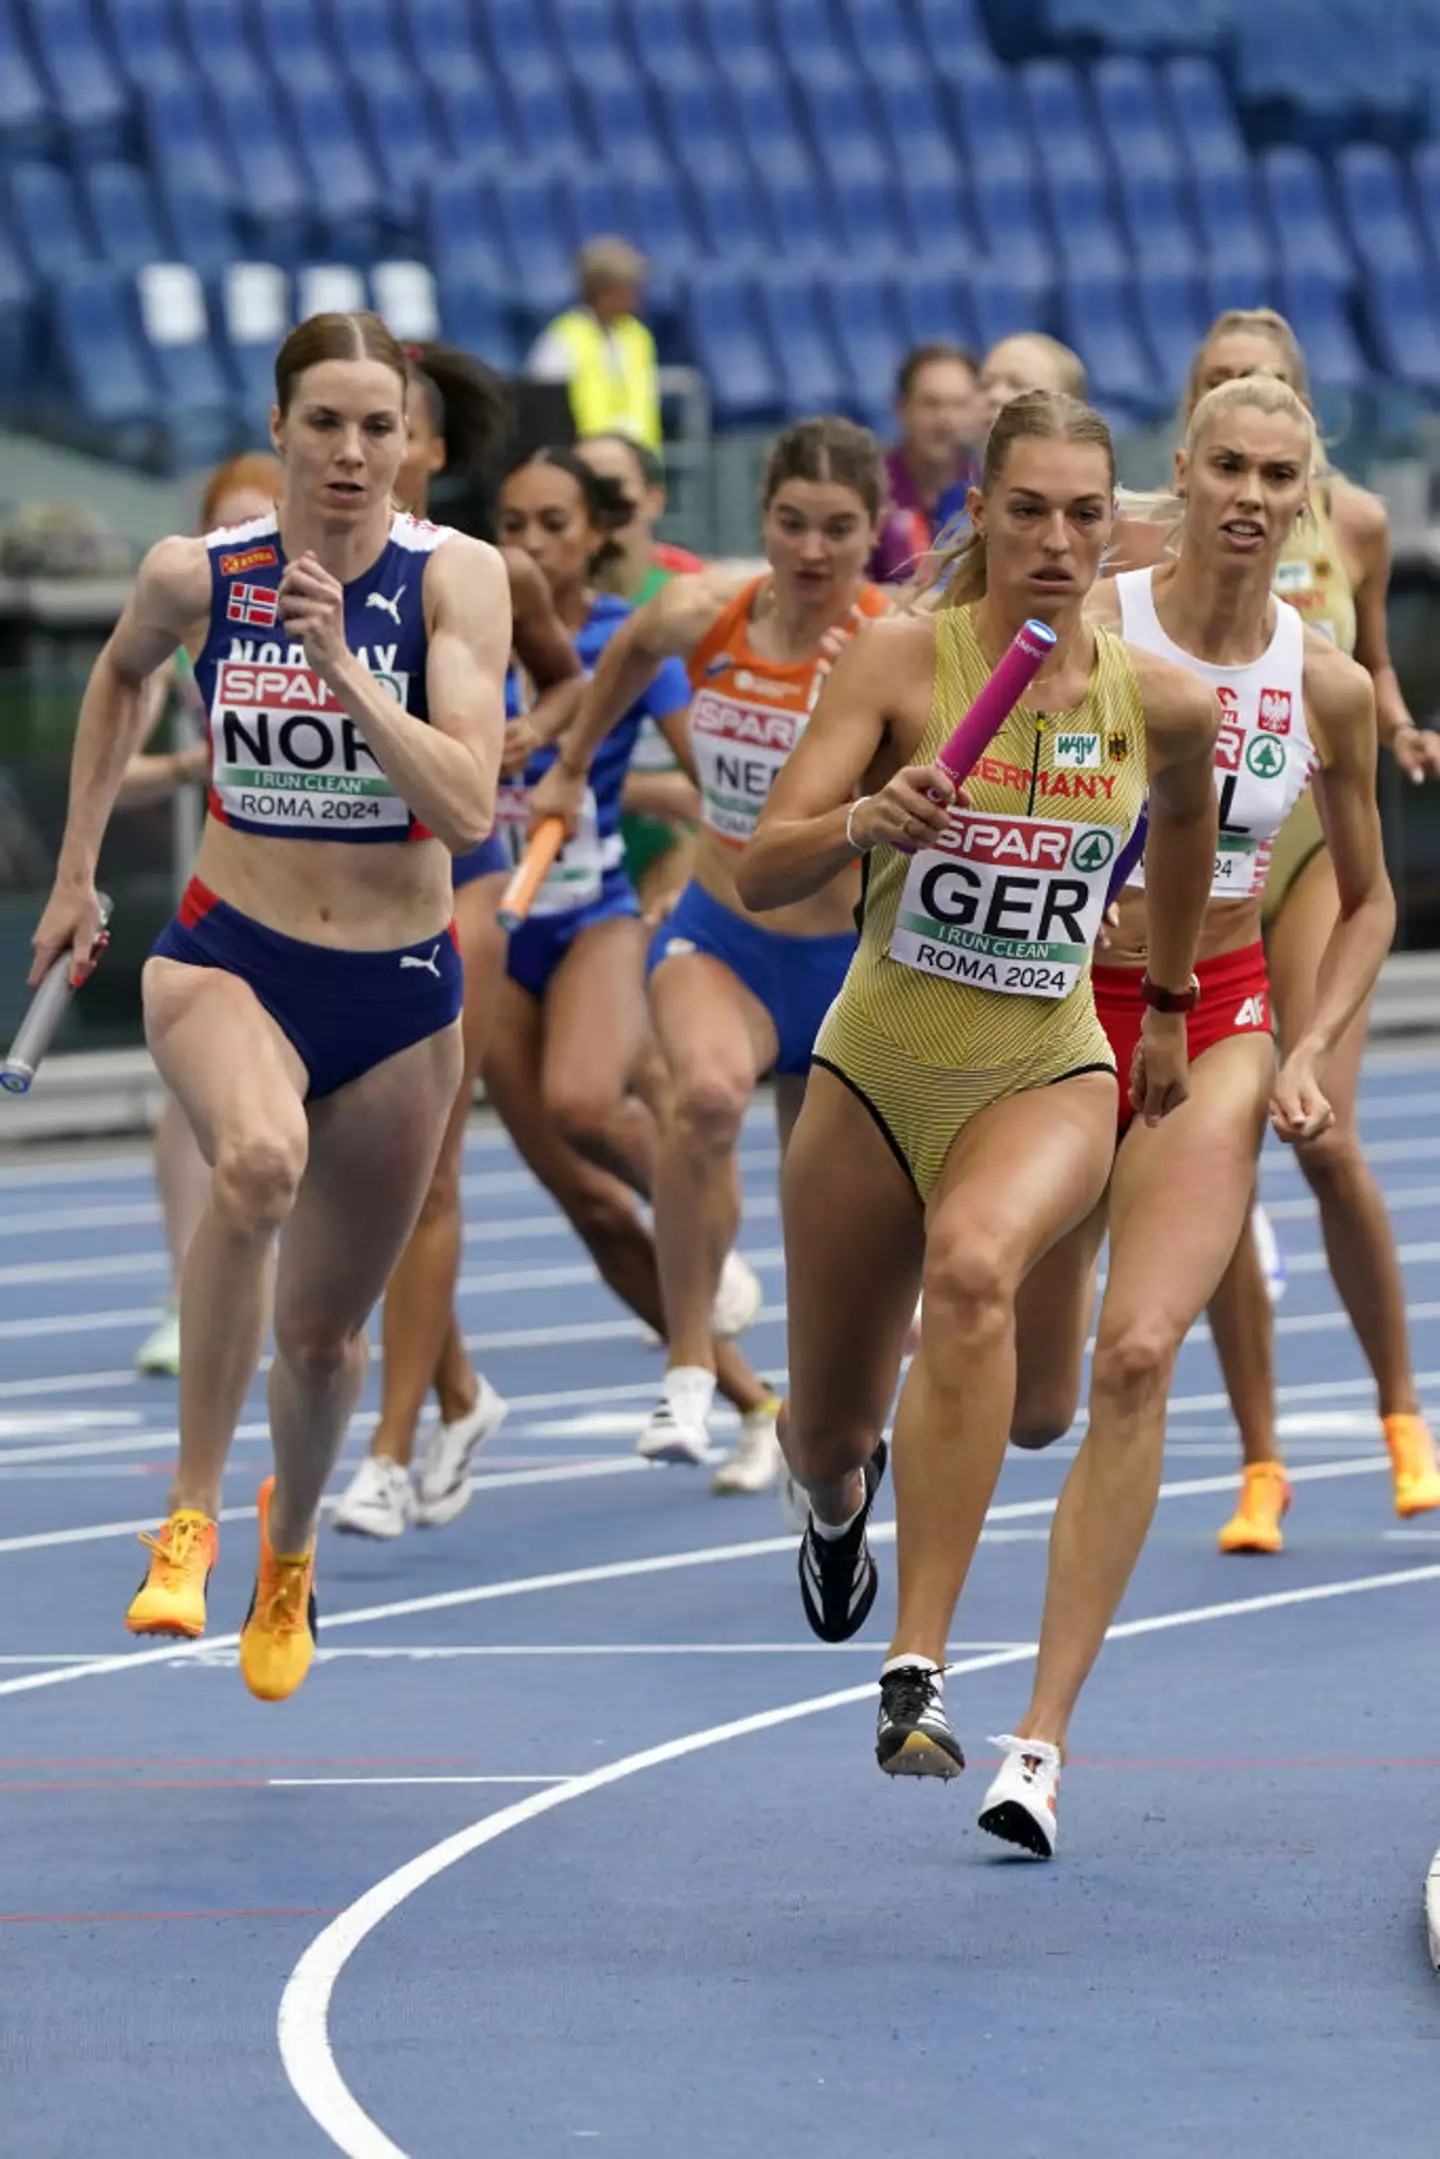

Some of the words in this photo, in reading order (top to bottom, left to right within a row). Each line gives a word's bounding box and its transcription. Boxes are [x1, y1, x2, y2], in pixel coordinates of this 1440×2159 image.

[695, 700, 793, 750] SPAR
[262, 773, 301, 788] RUN
[240, 793, 315, 819] ROMA
[320, 800, 381, 820] 2024
[937, 818, 1067, 864] SPAR
[920, 862, 1088, 944] GER
[948, 926, 991, 951] RUN
[916, 943, 998, 985] ROMA
[1004, 966, 1067, 991] 2024
